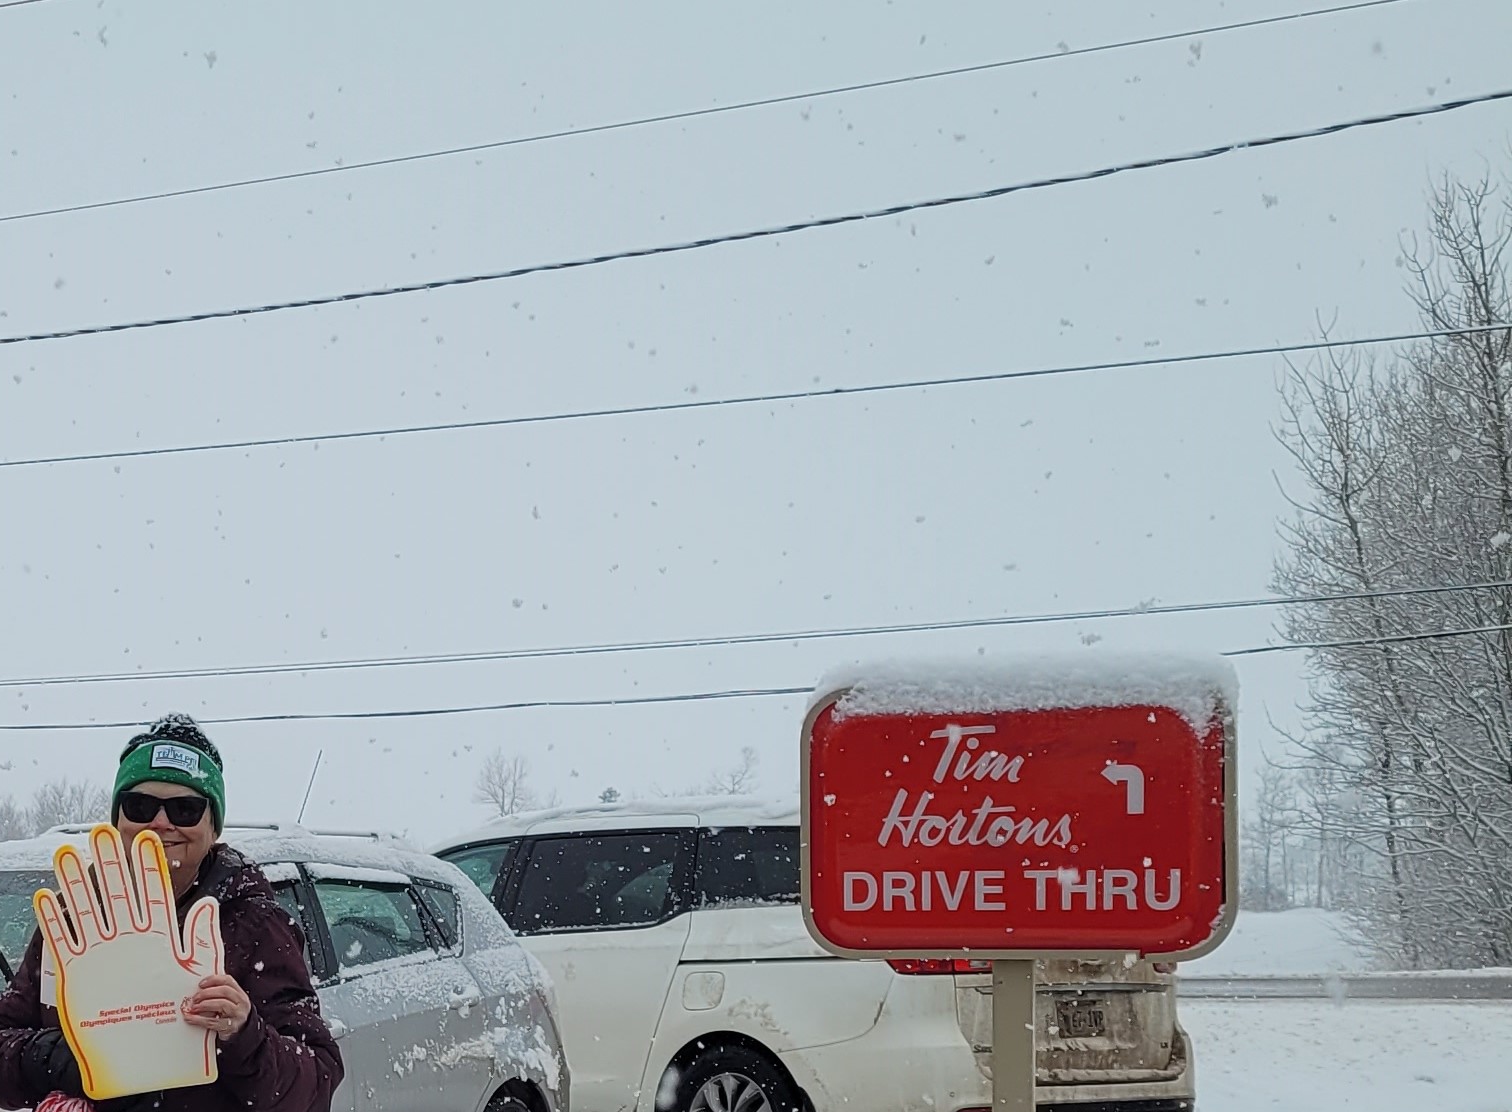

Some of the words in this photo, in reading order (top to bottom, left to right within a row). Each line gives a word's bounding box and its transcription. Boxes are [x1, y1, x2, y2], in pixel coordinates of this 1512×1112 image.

[930, 725, 1024, 784] Tim
[878, 788, 1073, 847] Hortons
[843, 870, 1006, 912] DRIVE
[1024, 868, 1181, 912] THRU
[80, 1015, 132, 1028] Olympiques
[99, 1006, 132, 1017] Special
[134, 1001, 175, 1013] Olympics
